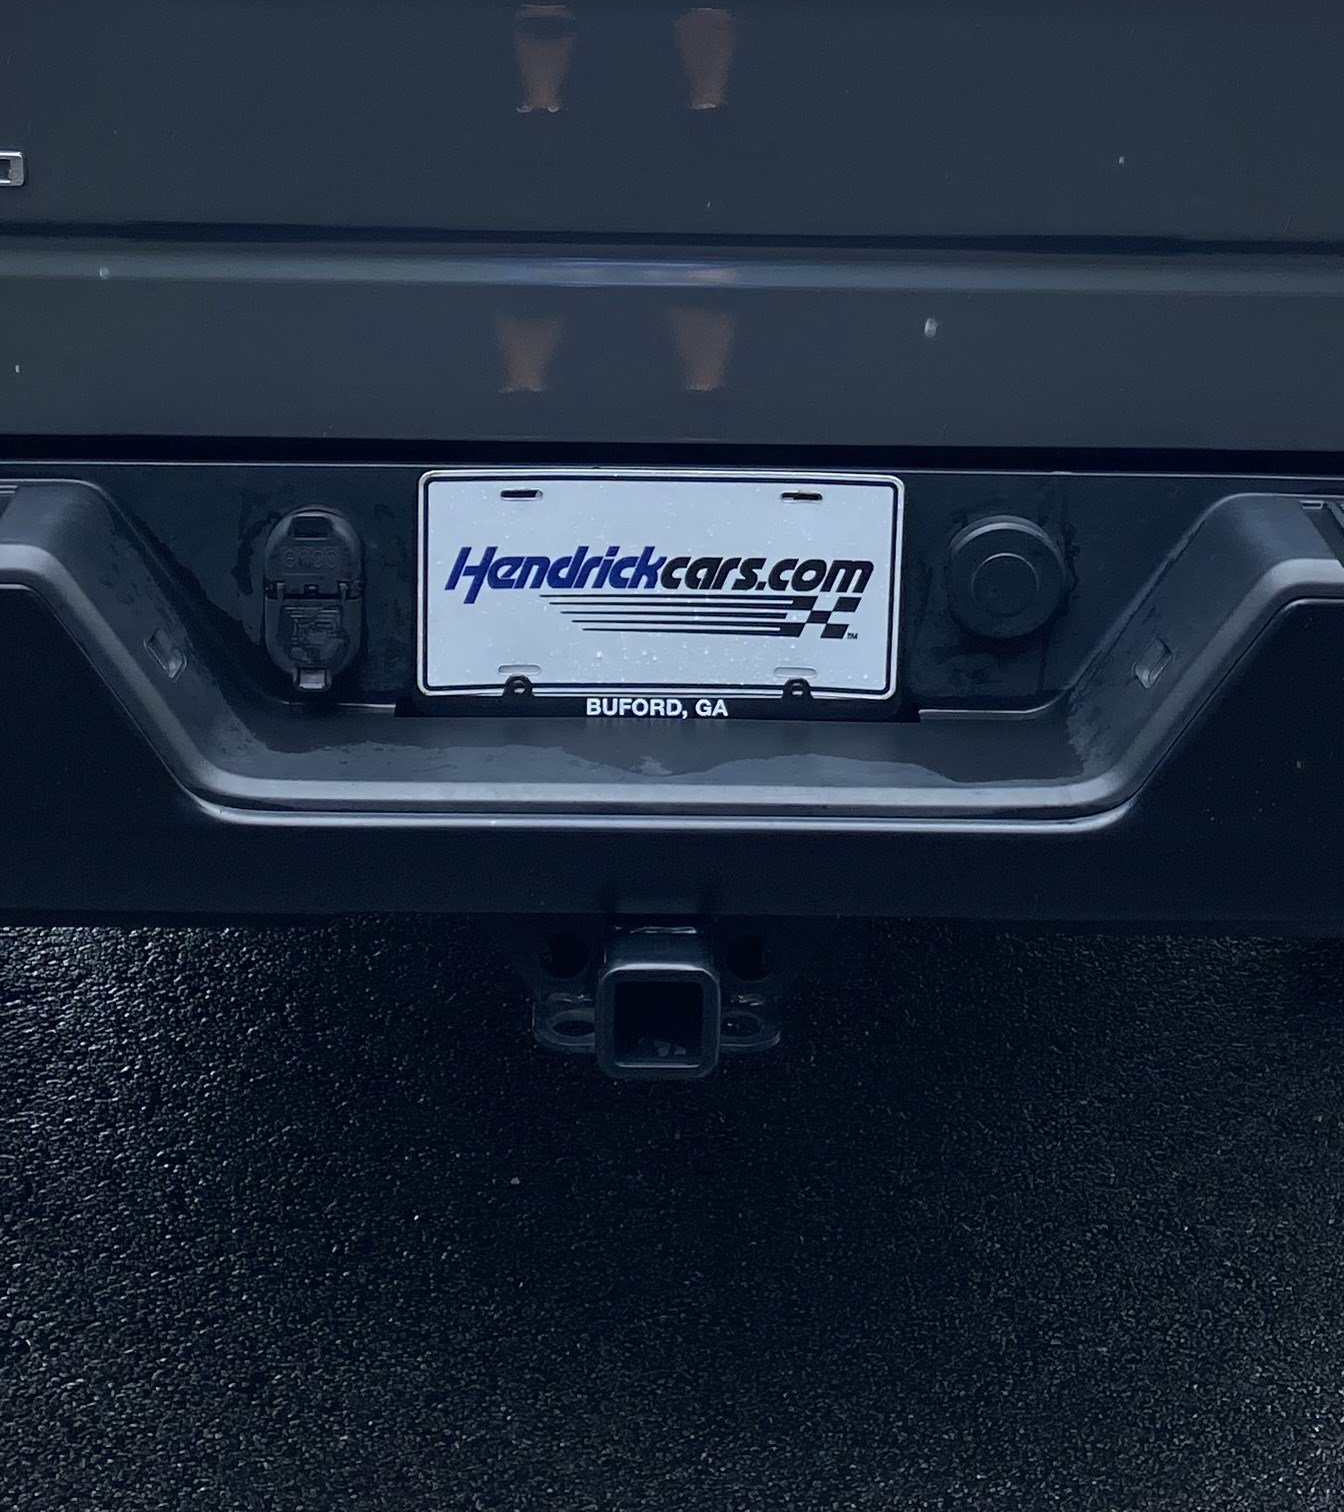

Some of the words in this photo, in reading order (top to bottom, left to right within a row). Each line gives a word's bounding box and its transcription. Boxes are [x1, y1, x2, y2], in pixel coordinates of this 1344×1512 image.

[444, 545, 874, 604] Hendrickcars.com
[586, 698, 687, 719] BUFORD,
[695, 700, 729, 718] GA
